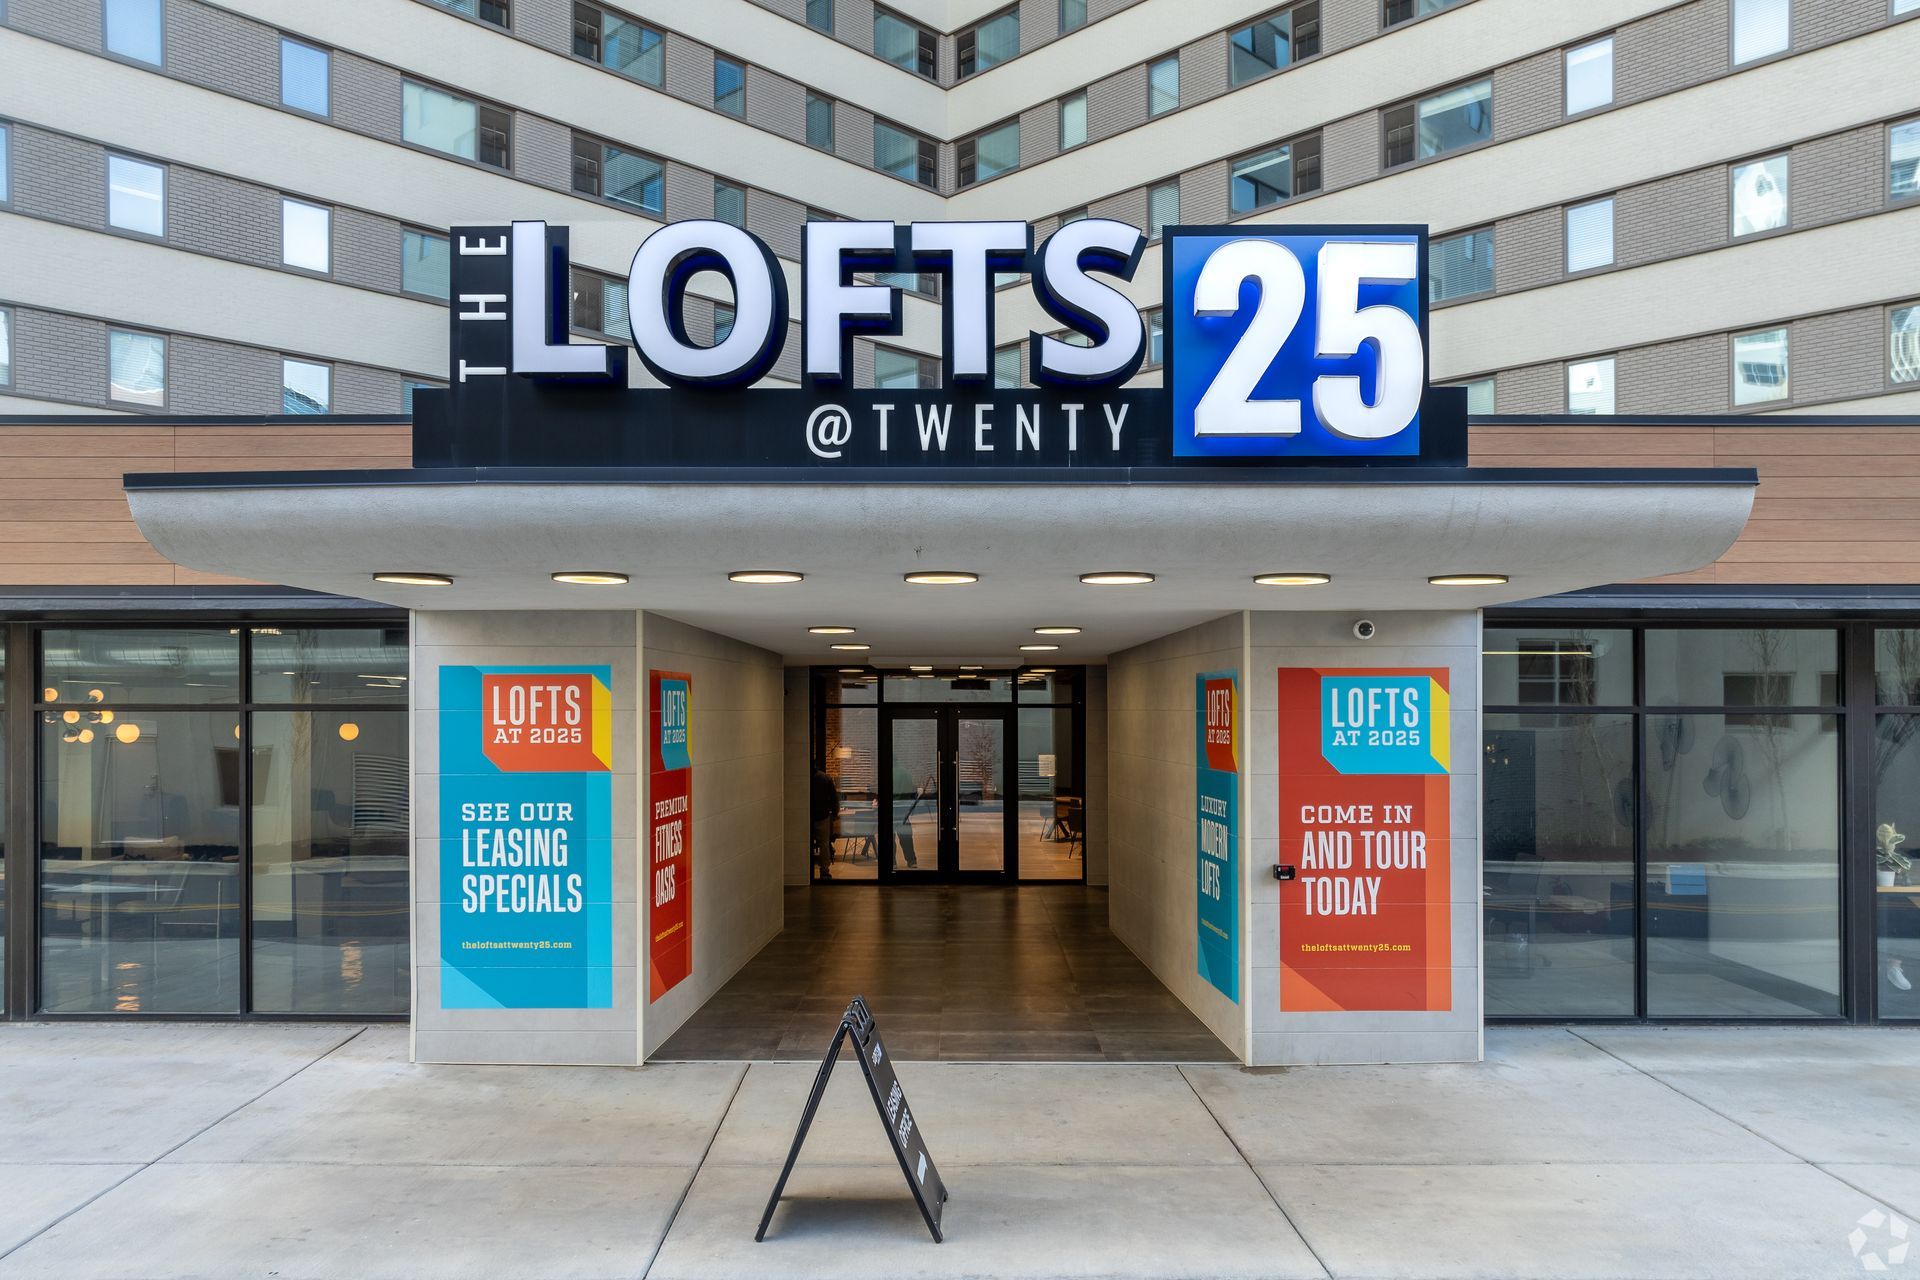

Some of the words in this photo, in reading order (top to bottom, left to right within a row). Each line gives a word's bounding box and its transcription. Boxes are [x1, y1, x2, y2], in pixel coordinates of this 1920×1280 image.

[459, 235, 507, 383] THE
[511, 218, 1146, 382] LOFTS
[1194, 238, 1423, 440] 25
[492, 685, 582, 726] LOFTS
[663, 690, 686, 727] LOFTS
[1207, 689, 1230, 727] LOFTS
[1331, 687, 1420, 728] LOFTS
[493, 728, 522, 744] AT
[530, 728, 582, 744] 2025
[663, 730, 671, 744] AT
[672, 729, 686, 743] 2025
[1207, 729, 1215, 743] AT
[1216, 730, 1231, 744] 2025
[1332, 730, 1361, 746] AT
[1368, 730, 1420, 746] 2025
[461, 803, 510, 822] SEE
[520, 803, 574, 822] OUR
[655, 795, 688, 820] PREMIUM
[1200, 795, 1227, 818] LUXURY
[1301, 805, 1374, 824] COME
[1383, 805, 1413, 824] IN
[462, 828, 568, 868] LEASING
[655, 819, 683, 864] FITNESS
[1201, 817, 1228, 862] MODERN
[1301, 831, 1353, 870] AND
[1360, 830, 1427, 870] TOUR
[462, 873, 583, 913] SPECIALS
[655, 863, 676, 908] OASIS
[1201, 858, 1220, 901] LOFTS
[1301, 876, 1382, 916] TODAY
[461, 940, 573, 950] theloftsattwenty25.com
[1301, 943, 1412, 953] theloftsattwenty25.com
